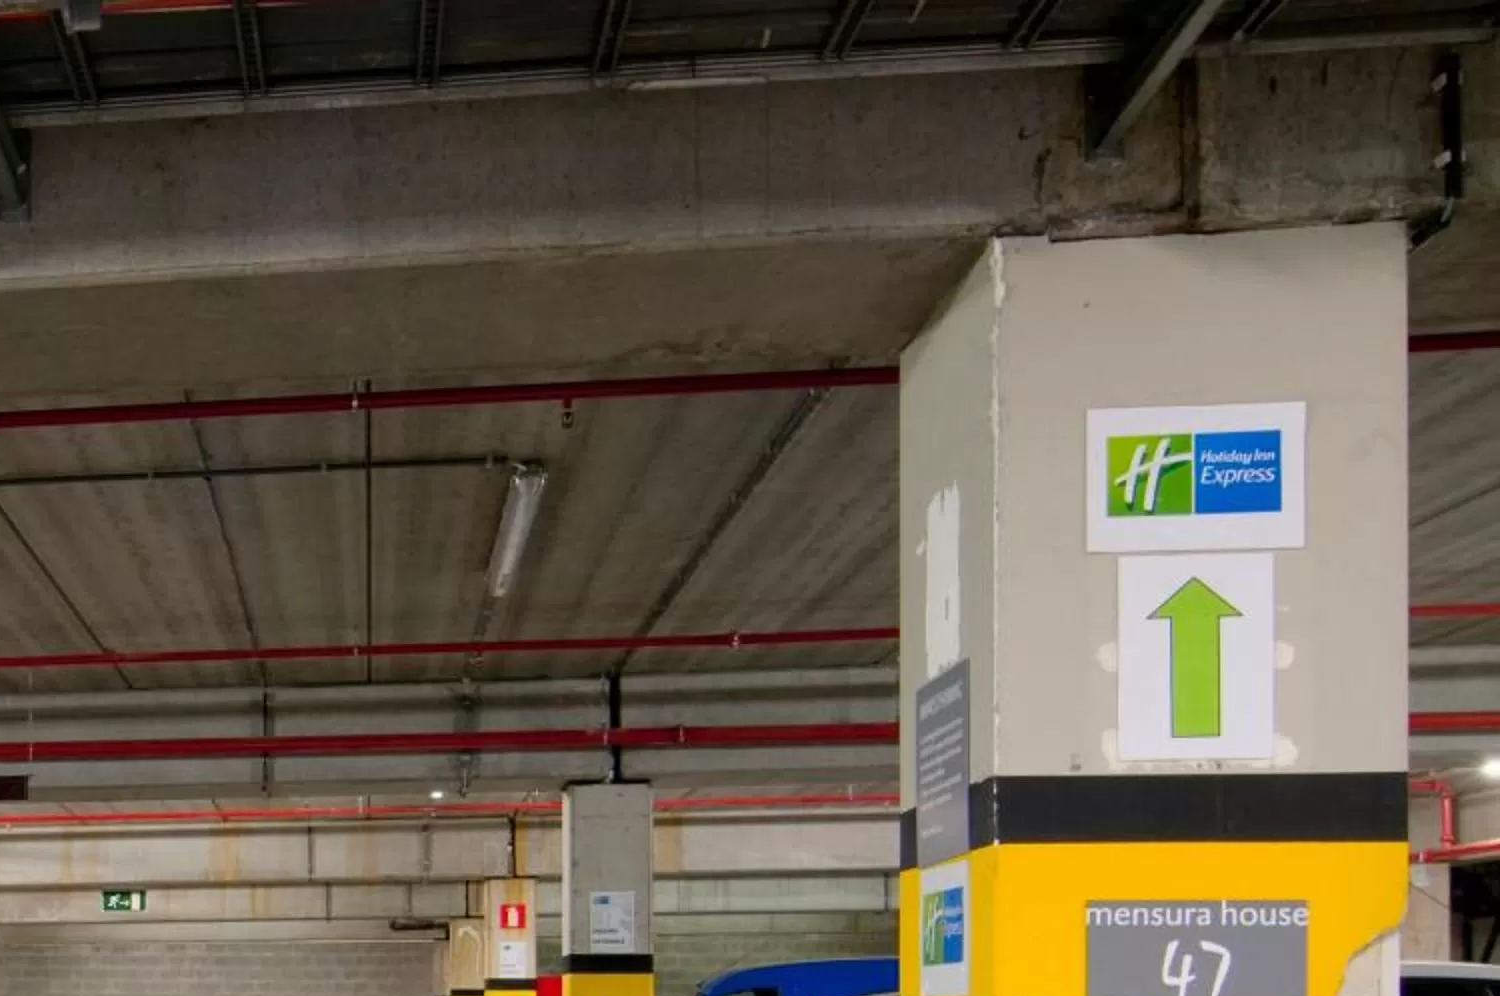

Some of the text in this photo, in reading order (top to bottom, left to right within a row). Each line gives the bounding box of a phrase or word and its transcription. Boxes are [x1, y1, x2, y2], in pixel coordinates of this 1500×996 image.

[1201, 447, 1275, 464] Holiday Inn
[1201, 465, 1275, 488] Express
[1085, 899, 1311, 926] mensura house
